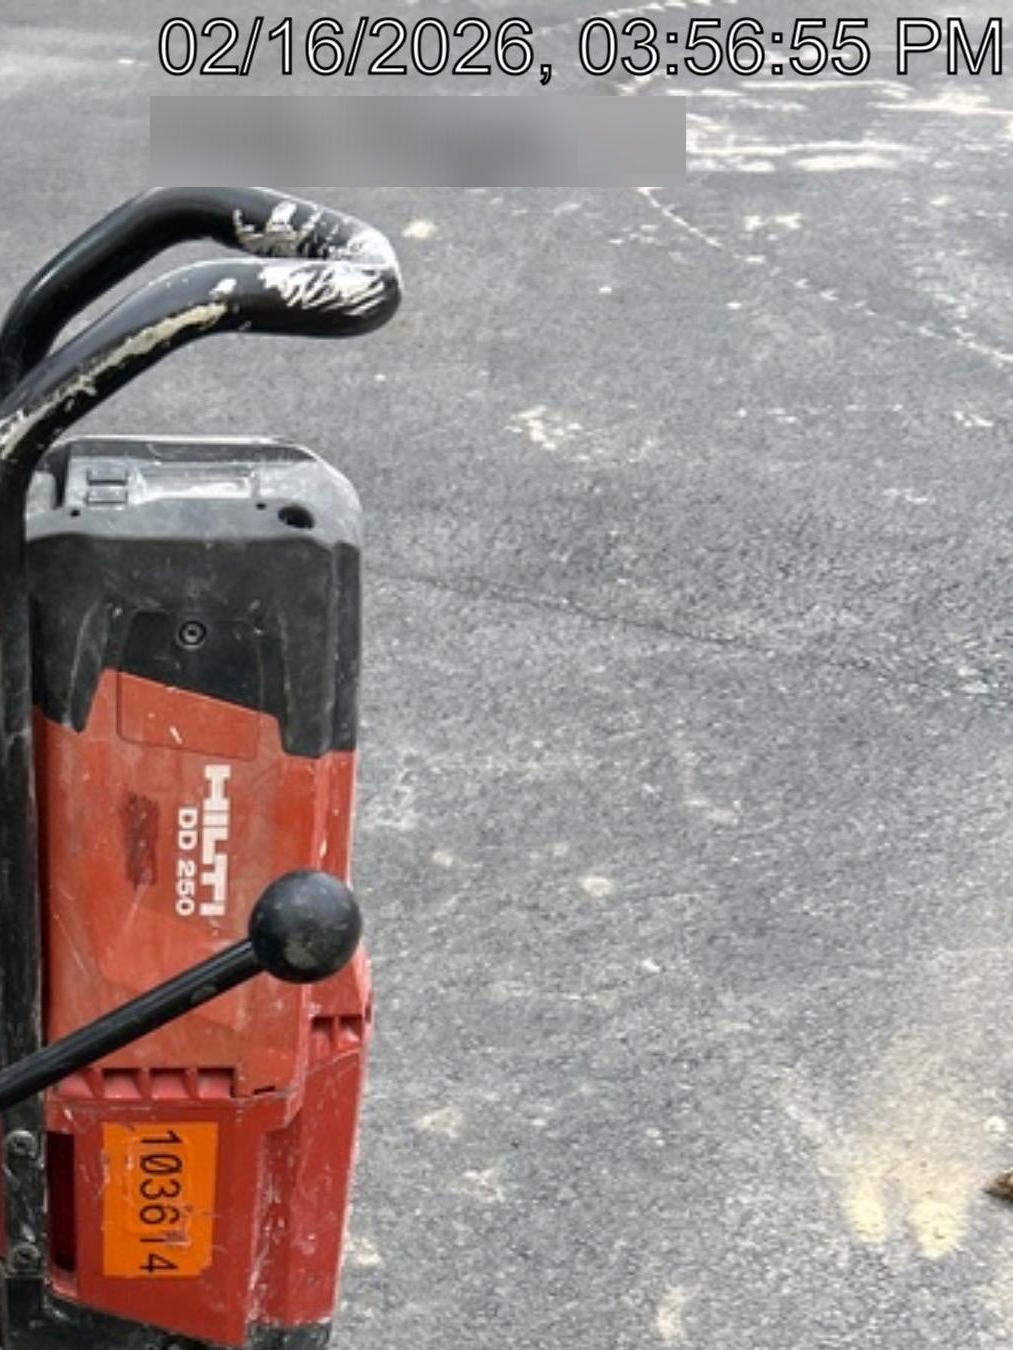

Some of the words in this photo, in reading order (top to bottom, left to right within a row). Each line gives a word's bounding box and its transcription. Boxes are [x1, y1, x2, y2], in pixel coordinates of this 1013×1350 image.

[178, 807, 198, 850] DD
[199, 764, 231, 916] HILTI
[175, 859, 197, 916] 250
[139, 1130, 183, 1273] 103614
